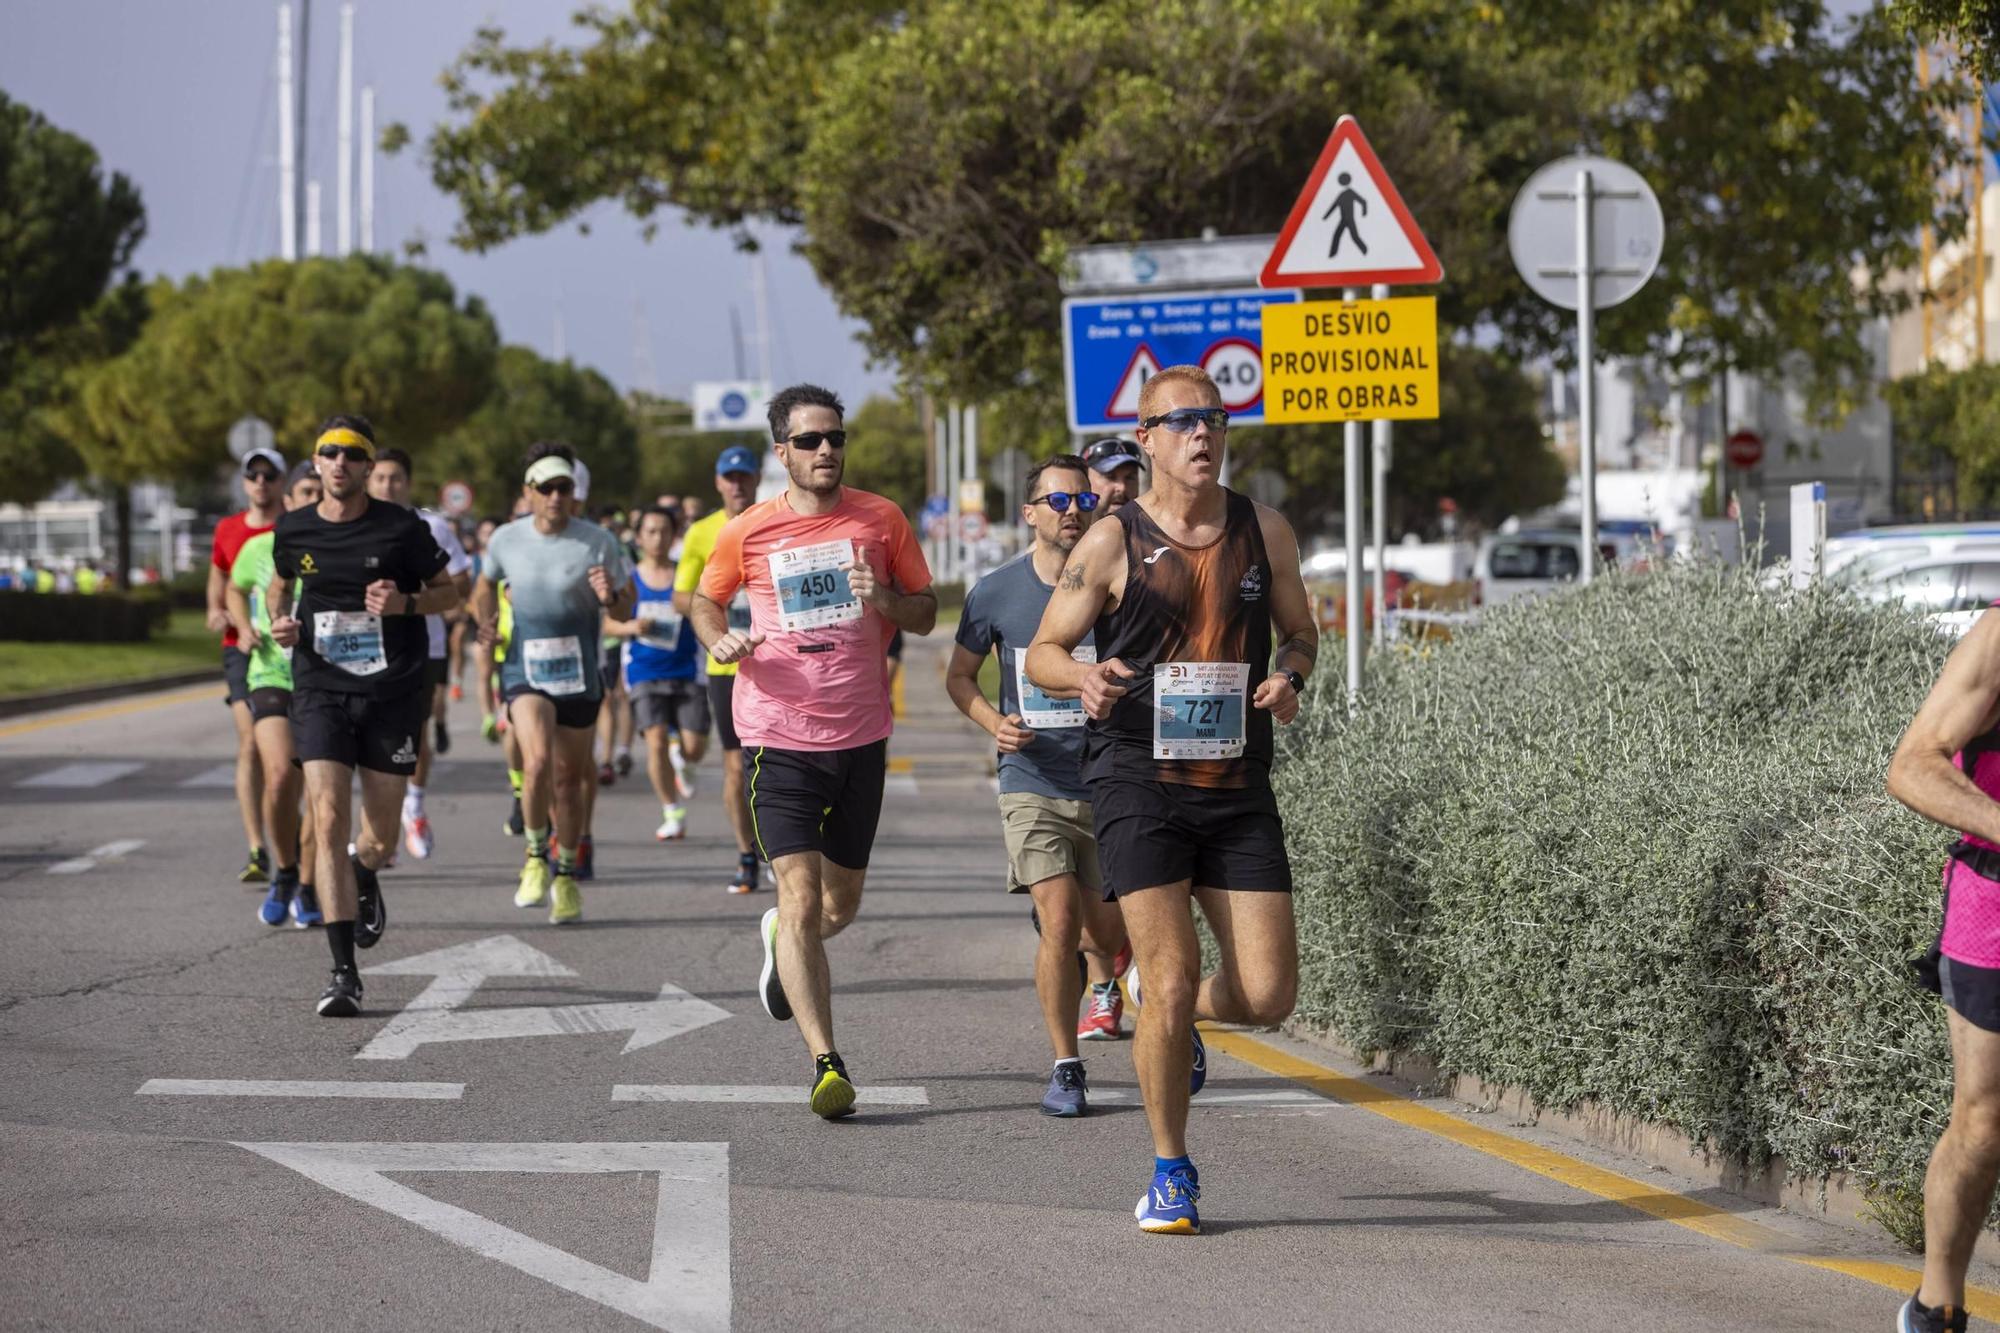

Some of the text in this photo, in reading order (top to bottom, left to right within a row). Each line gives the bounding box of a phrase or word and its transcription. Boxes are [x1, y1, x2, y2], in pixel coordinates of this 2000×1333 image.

[1305, 311, 1391, 337] DESVIO
[1271, 347, 1428, 375] PROVISIONAL
[1215, 362, 1256, 385] 40
[1283, 384, 1418, 411] POR OBRAS
[781, 552, 797, 562] 31
[801, 573, 836, 597] 450
[339, 635, 359, 653] 38
[1170, 666, 1187, 678] 31
[1185, 700, 1224, 724] 727
[1196, 728, 1216, 737] MANU
